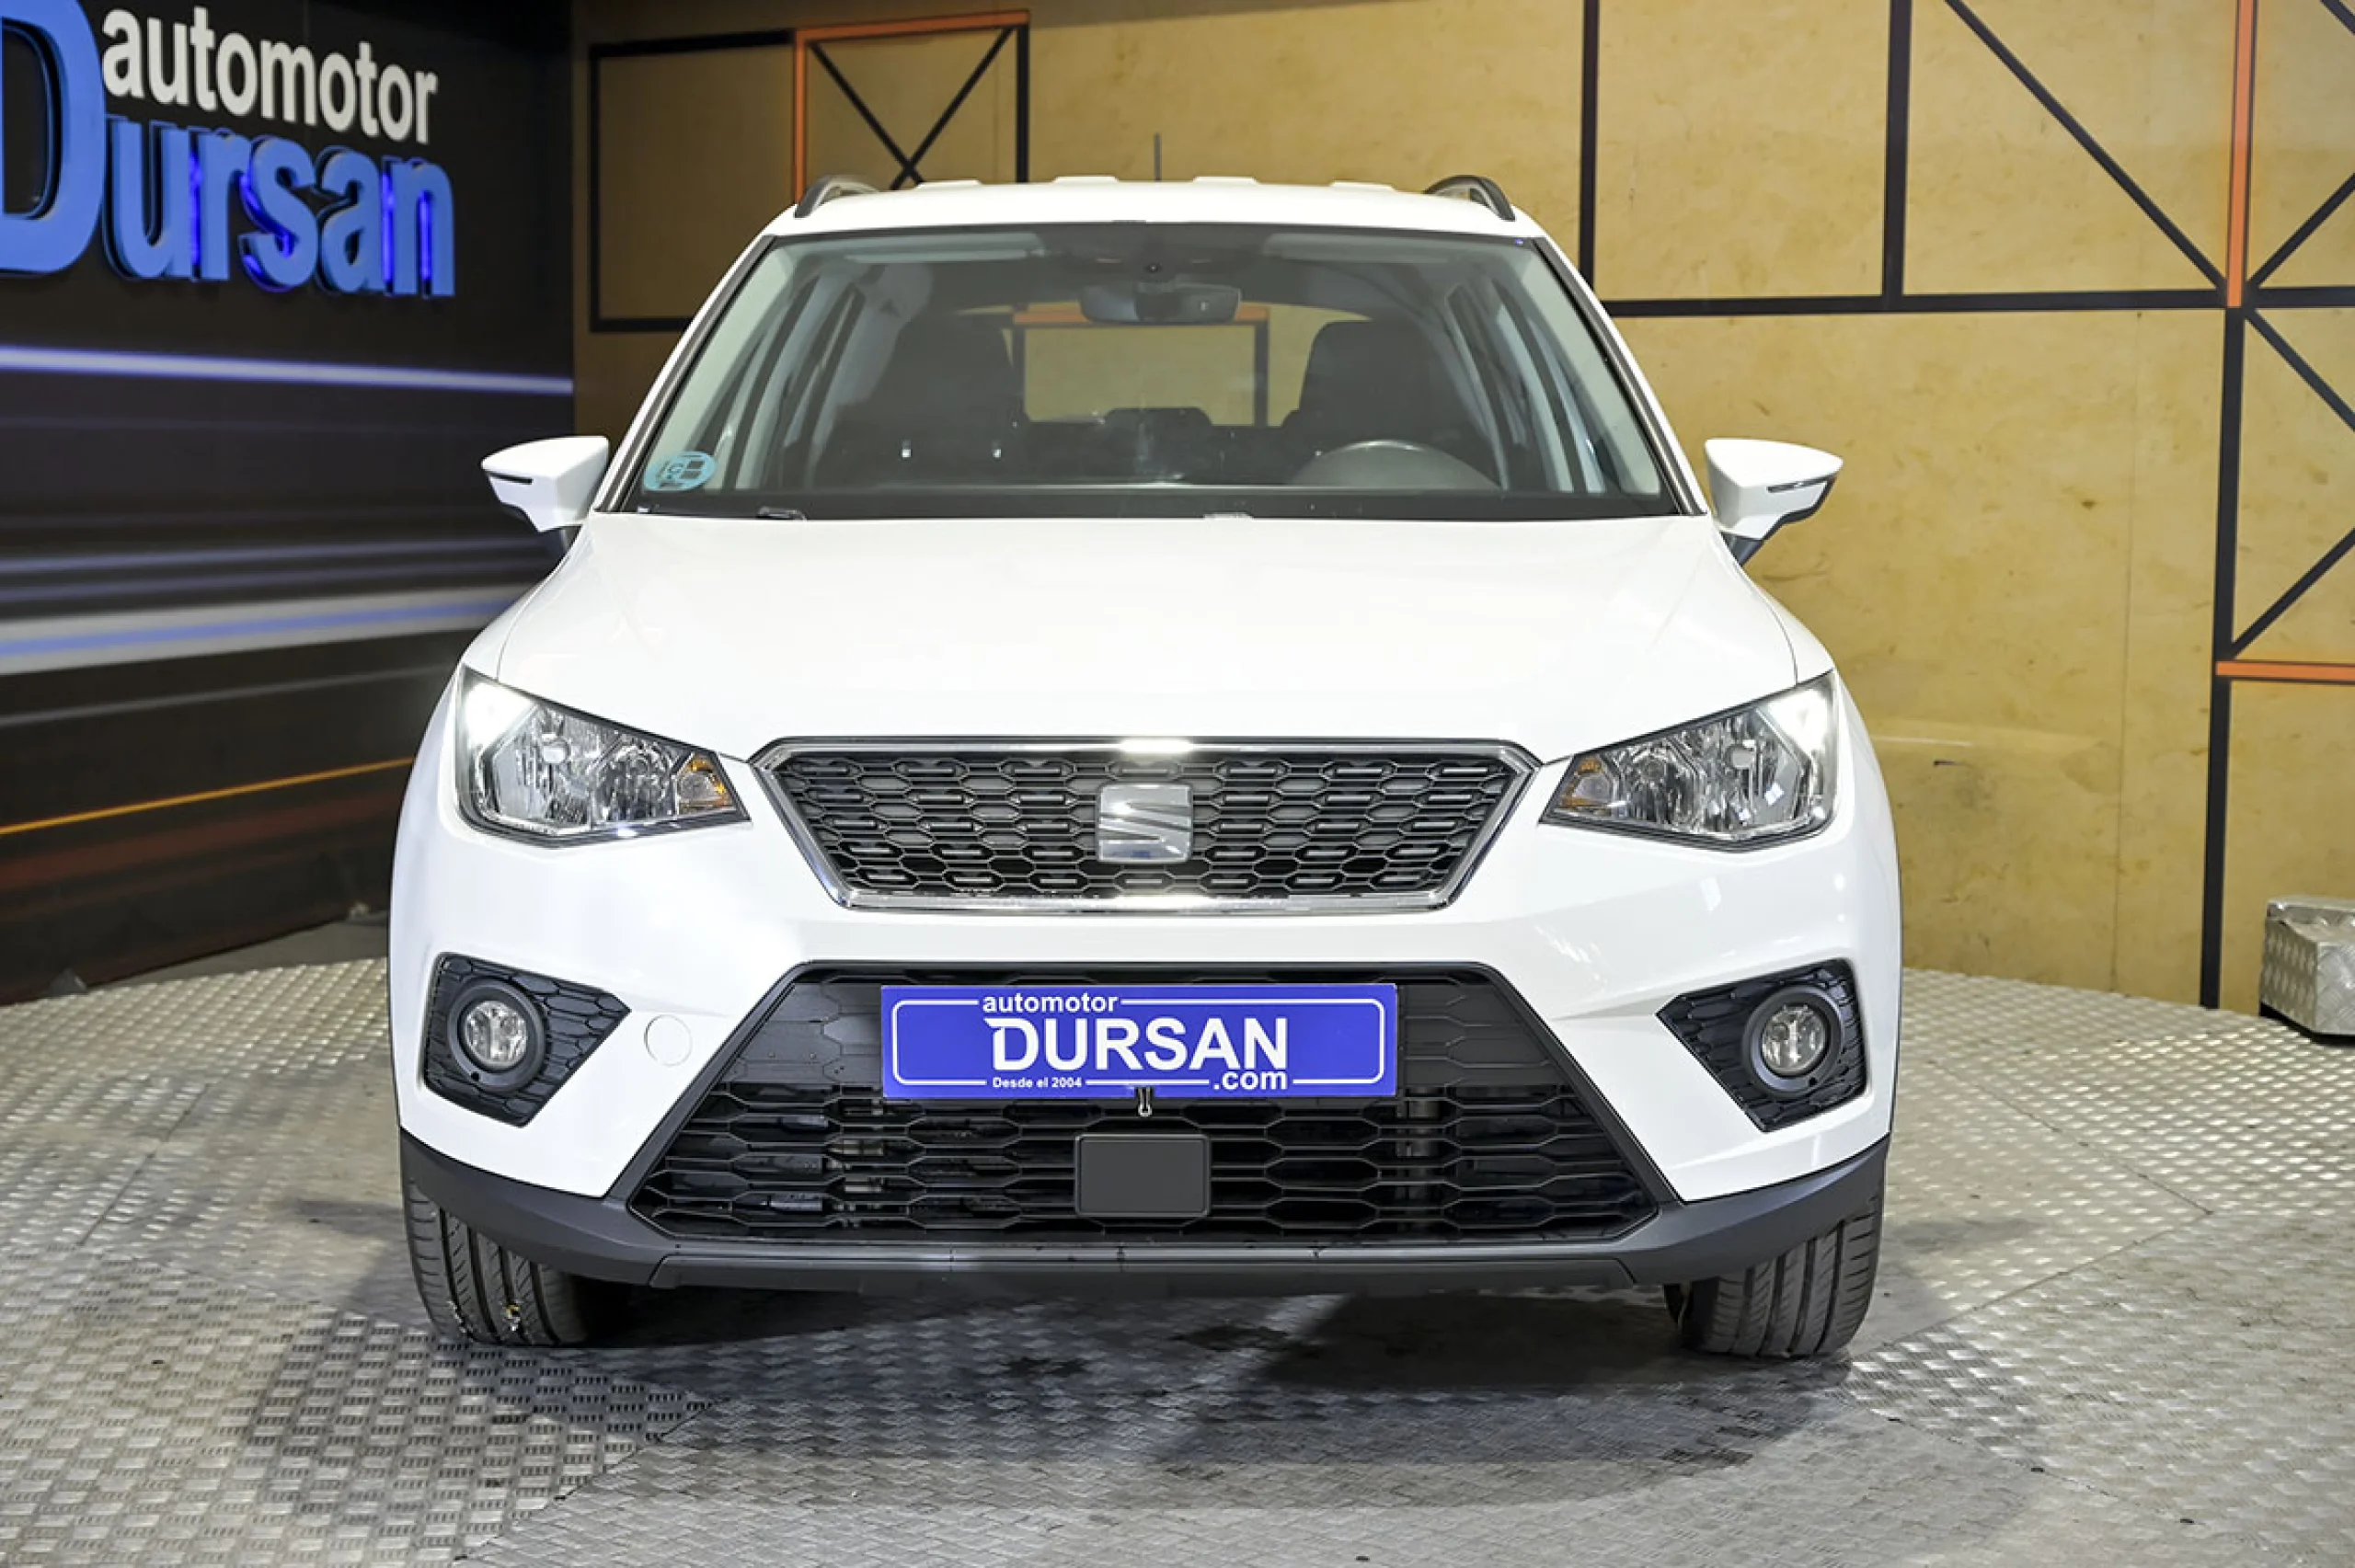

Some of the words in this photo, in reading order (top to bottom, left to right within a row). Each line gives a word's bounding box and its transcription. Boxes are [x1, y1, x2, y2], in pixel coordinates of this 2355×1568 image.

[102, 6, 438, 144] automotor
[0, 0, 456, 298] Dursan
[982, 992, 1120, 1013] automotor
[982, 1016, 1288, 1071] DURSAN
[992, 1076, 1033, 1088] Desde
[1035, 1076, 1049, 1088] el
[1051, 1076, 1083, 1088] 2004
[1212, 1070, 1288, 1091] .com
